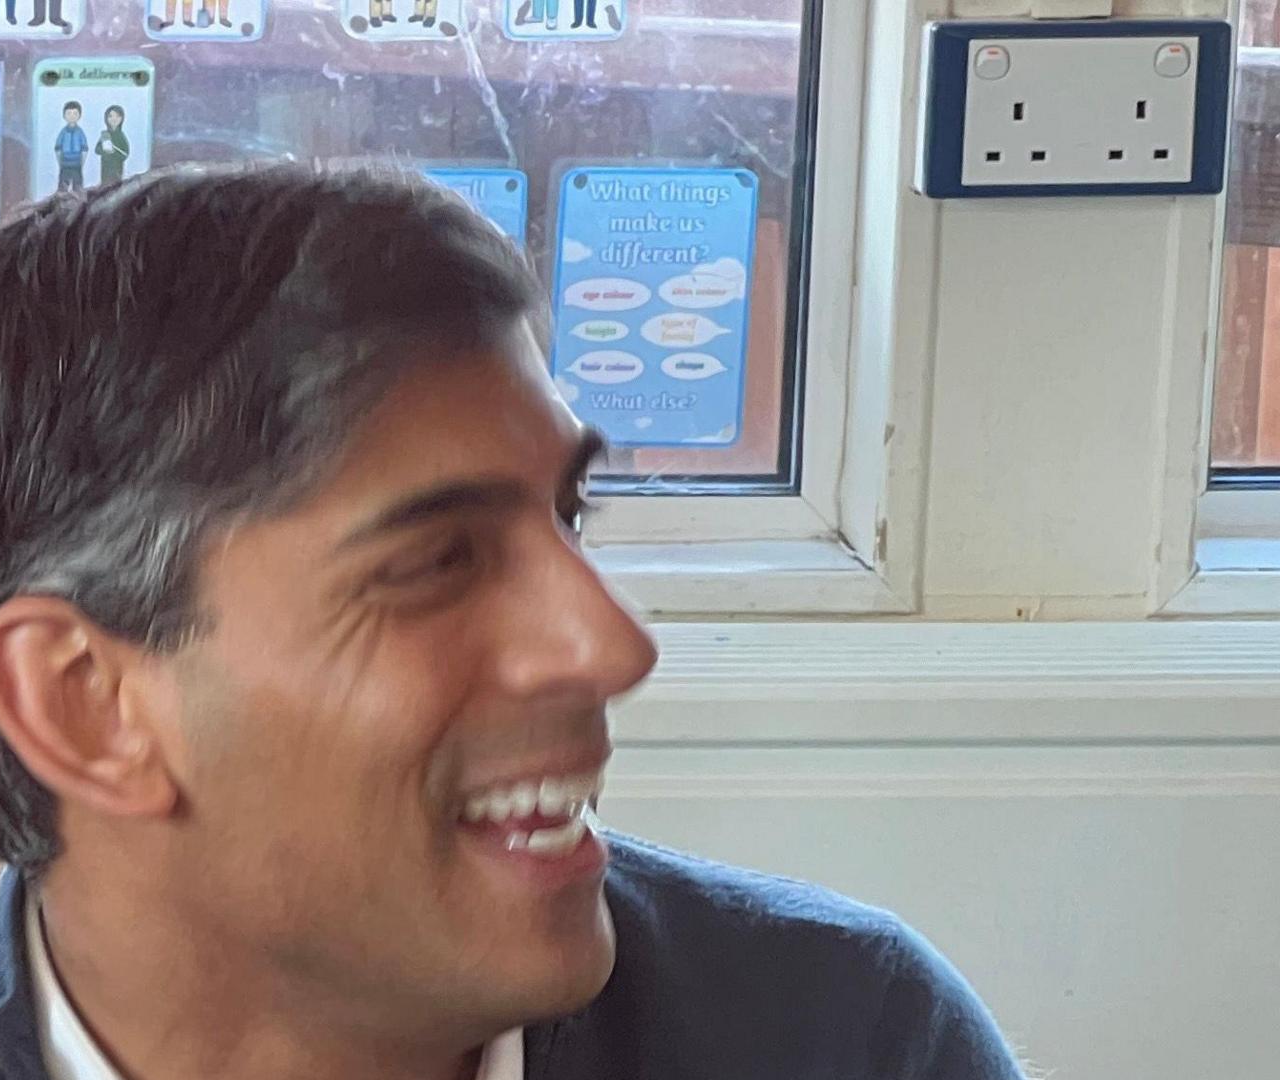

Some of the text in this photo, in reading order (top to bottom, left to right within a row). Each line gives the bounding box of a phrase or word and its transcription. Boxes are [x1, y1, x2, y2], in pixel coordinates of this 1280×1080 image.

[590, 178, 730, 207] What things
[610, 212, 705, 232] make us
[600, 241, 712, 269] different?
[591, 391, 697, 411] What else?
